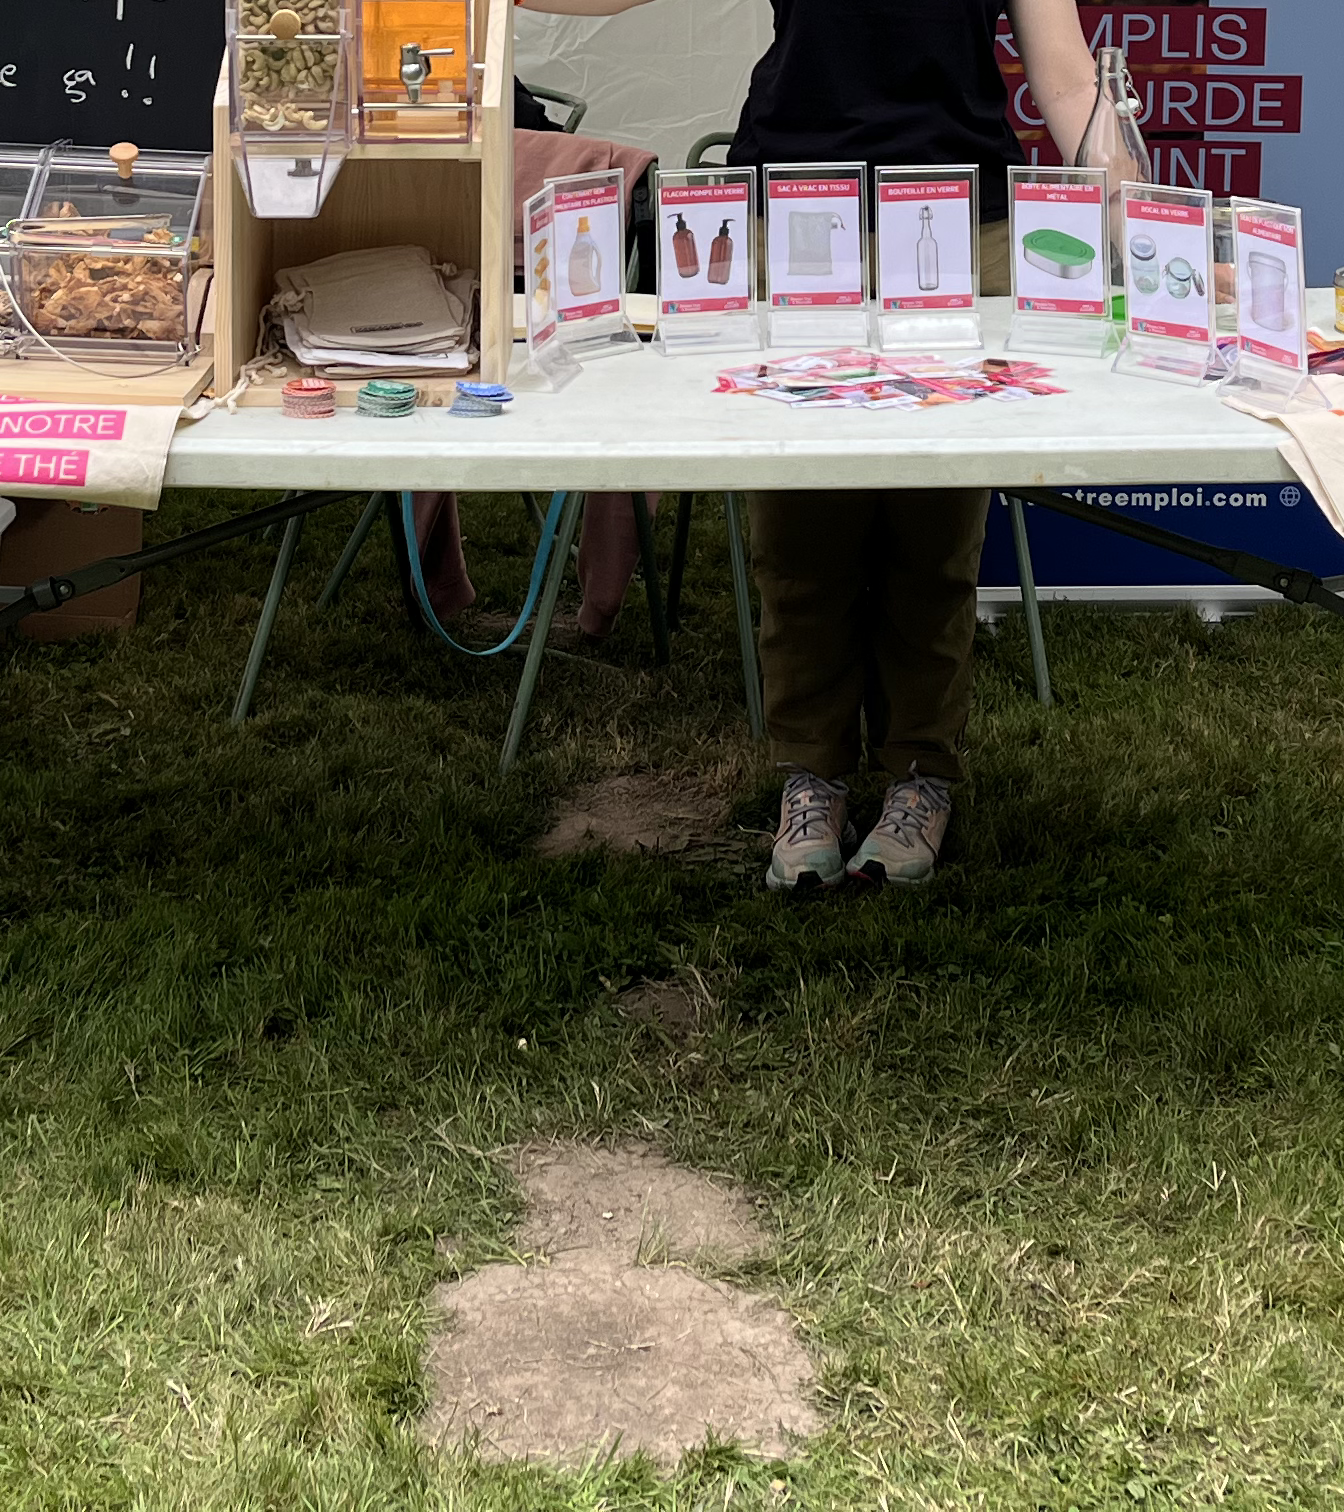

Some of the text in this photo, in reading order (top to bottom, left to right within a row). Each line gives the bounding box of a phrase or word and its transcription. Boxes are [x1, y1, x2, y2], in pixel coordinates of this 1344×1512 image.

[63, 69, 97, 105] ça
[662, 189, 689, 198] FLACON
[0, 412, 119, 436] NOTRE
[17, 450, 79, 482] THÉ
